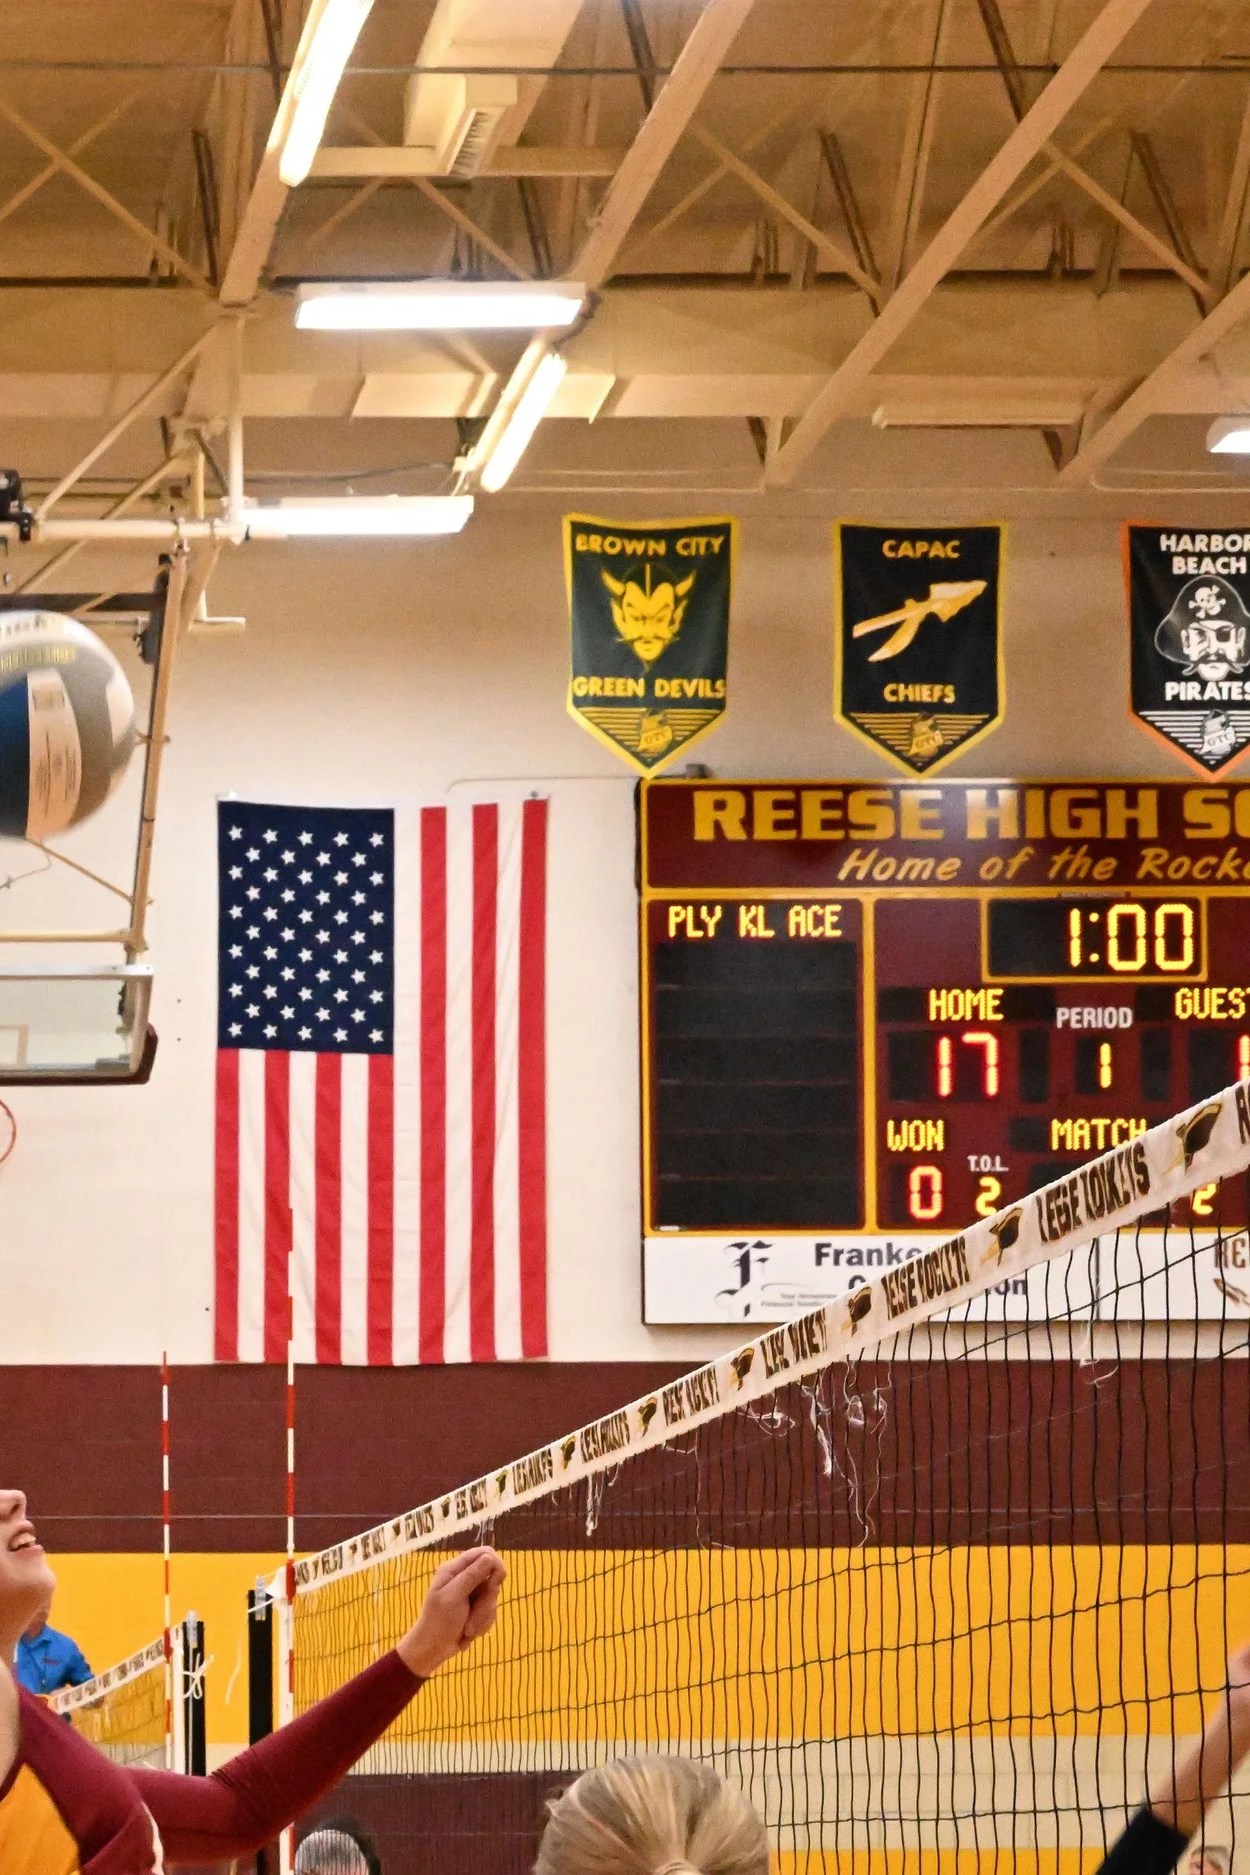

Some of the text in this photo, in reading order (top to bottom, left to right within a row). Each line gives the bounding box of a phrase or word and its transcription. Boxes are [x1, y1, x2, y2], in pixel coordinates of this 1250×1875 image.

[575, 533, 725, 556] BROWN CITY
[881, 540, 961, 559] CAPAC
[1172, 556, 1248, 575] BEACH
[572, 676, 726, 699] GREEN DEVILS
[883, 683, 956, 704] CHIEFS
[692, 789, 945, 841] REESE
[965, 788, 1158, 840] HIGH
[837, 847, 959, 882] Home
[978, 846, 1035, 881] of
[1049, 845, 1119, 880] the
[668, 903, 843, 939] PLY KL ACE
[1069, 902, 1194, 972] 1:00
[928, 988, 1005, 1021] HOME
[1056, 1007, 1134, 1029] PERIOD
[937, 1031, 1000, 1097] 17
[1098, 1042, 1113, 1090] 1
[886, 1118, 945, 1152] WON
[1050, 1117, 1149, 1151] MATCH
[967, 1155, 1009, 1173] T.O.L.
[909, 1165, 943, 1220] 0
[975, 1176, 1002, 1218] 2
